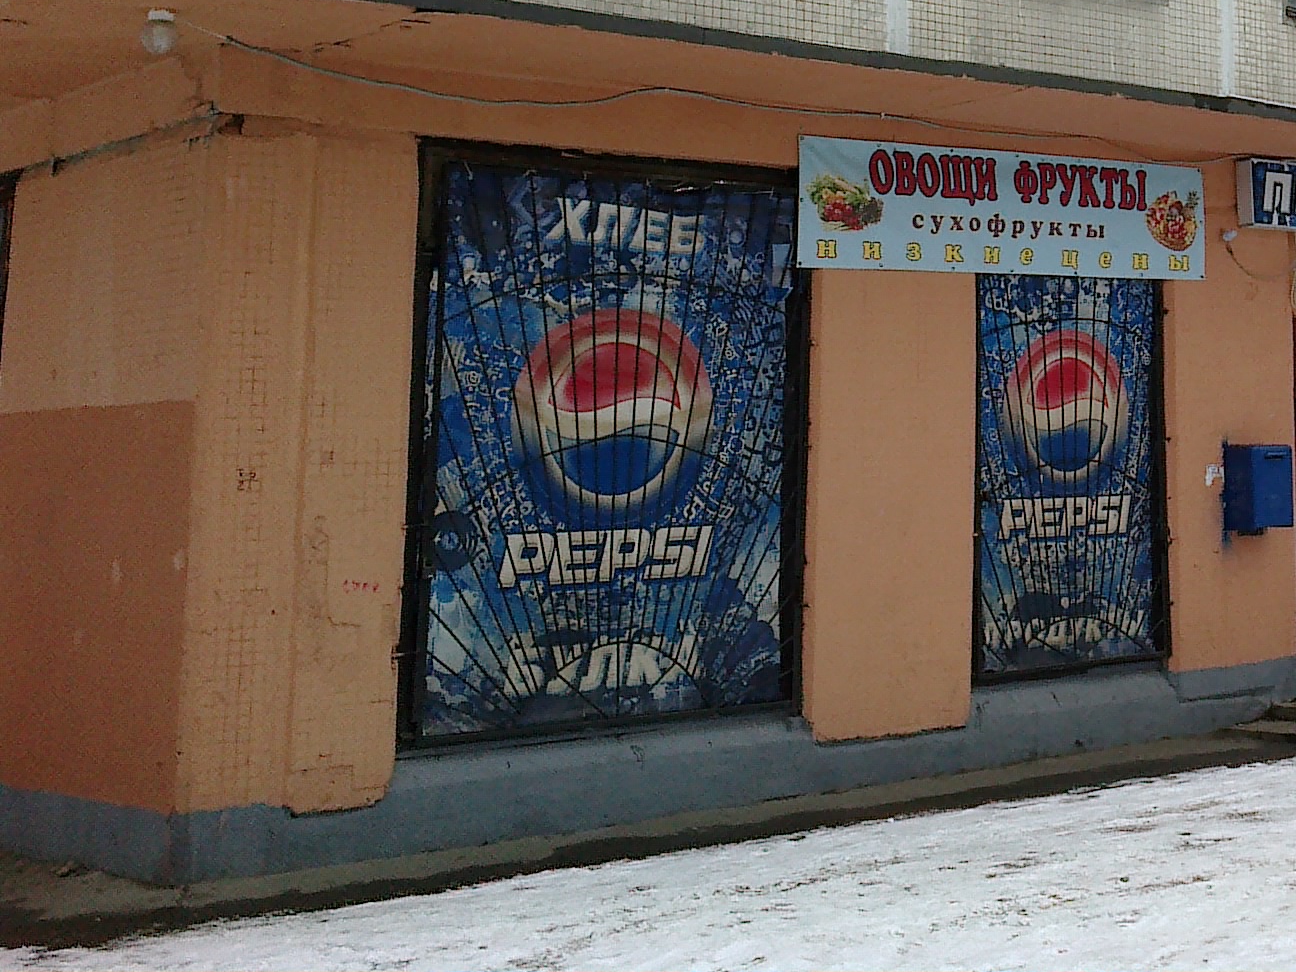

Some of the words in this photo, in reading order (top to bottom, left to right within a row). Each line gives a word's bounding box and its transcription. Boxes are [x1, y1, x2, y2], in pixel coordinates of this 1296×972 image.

[869, 149, 998, 206] ОВОЩИ
[1014, 160, 1148, 212] ФРУКТЫ
[545, 197, 706, 254] ХЛЕБ
[912, 212, 1106, 240] сухофрукты
[1000, 494, 1131, 540] PEPSI
[499, 524, 714, 589] PEPSI
